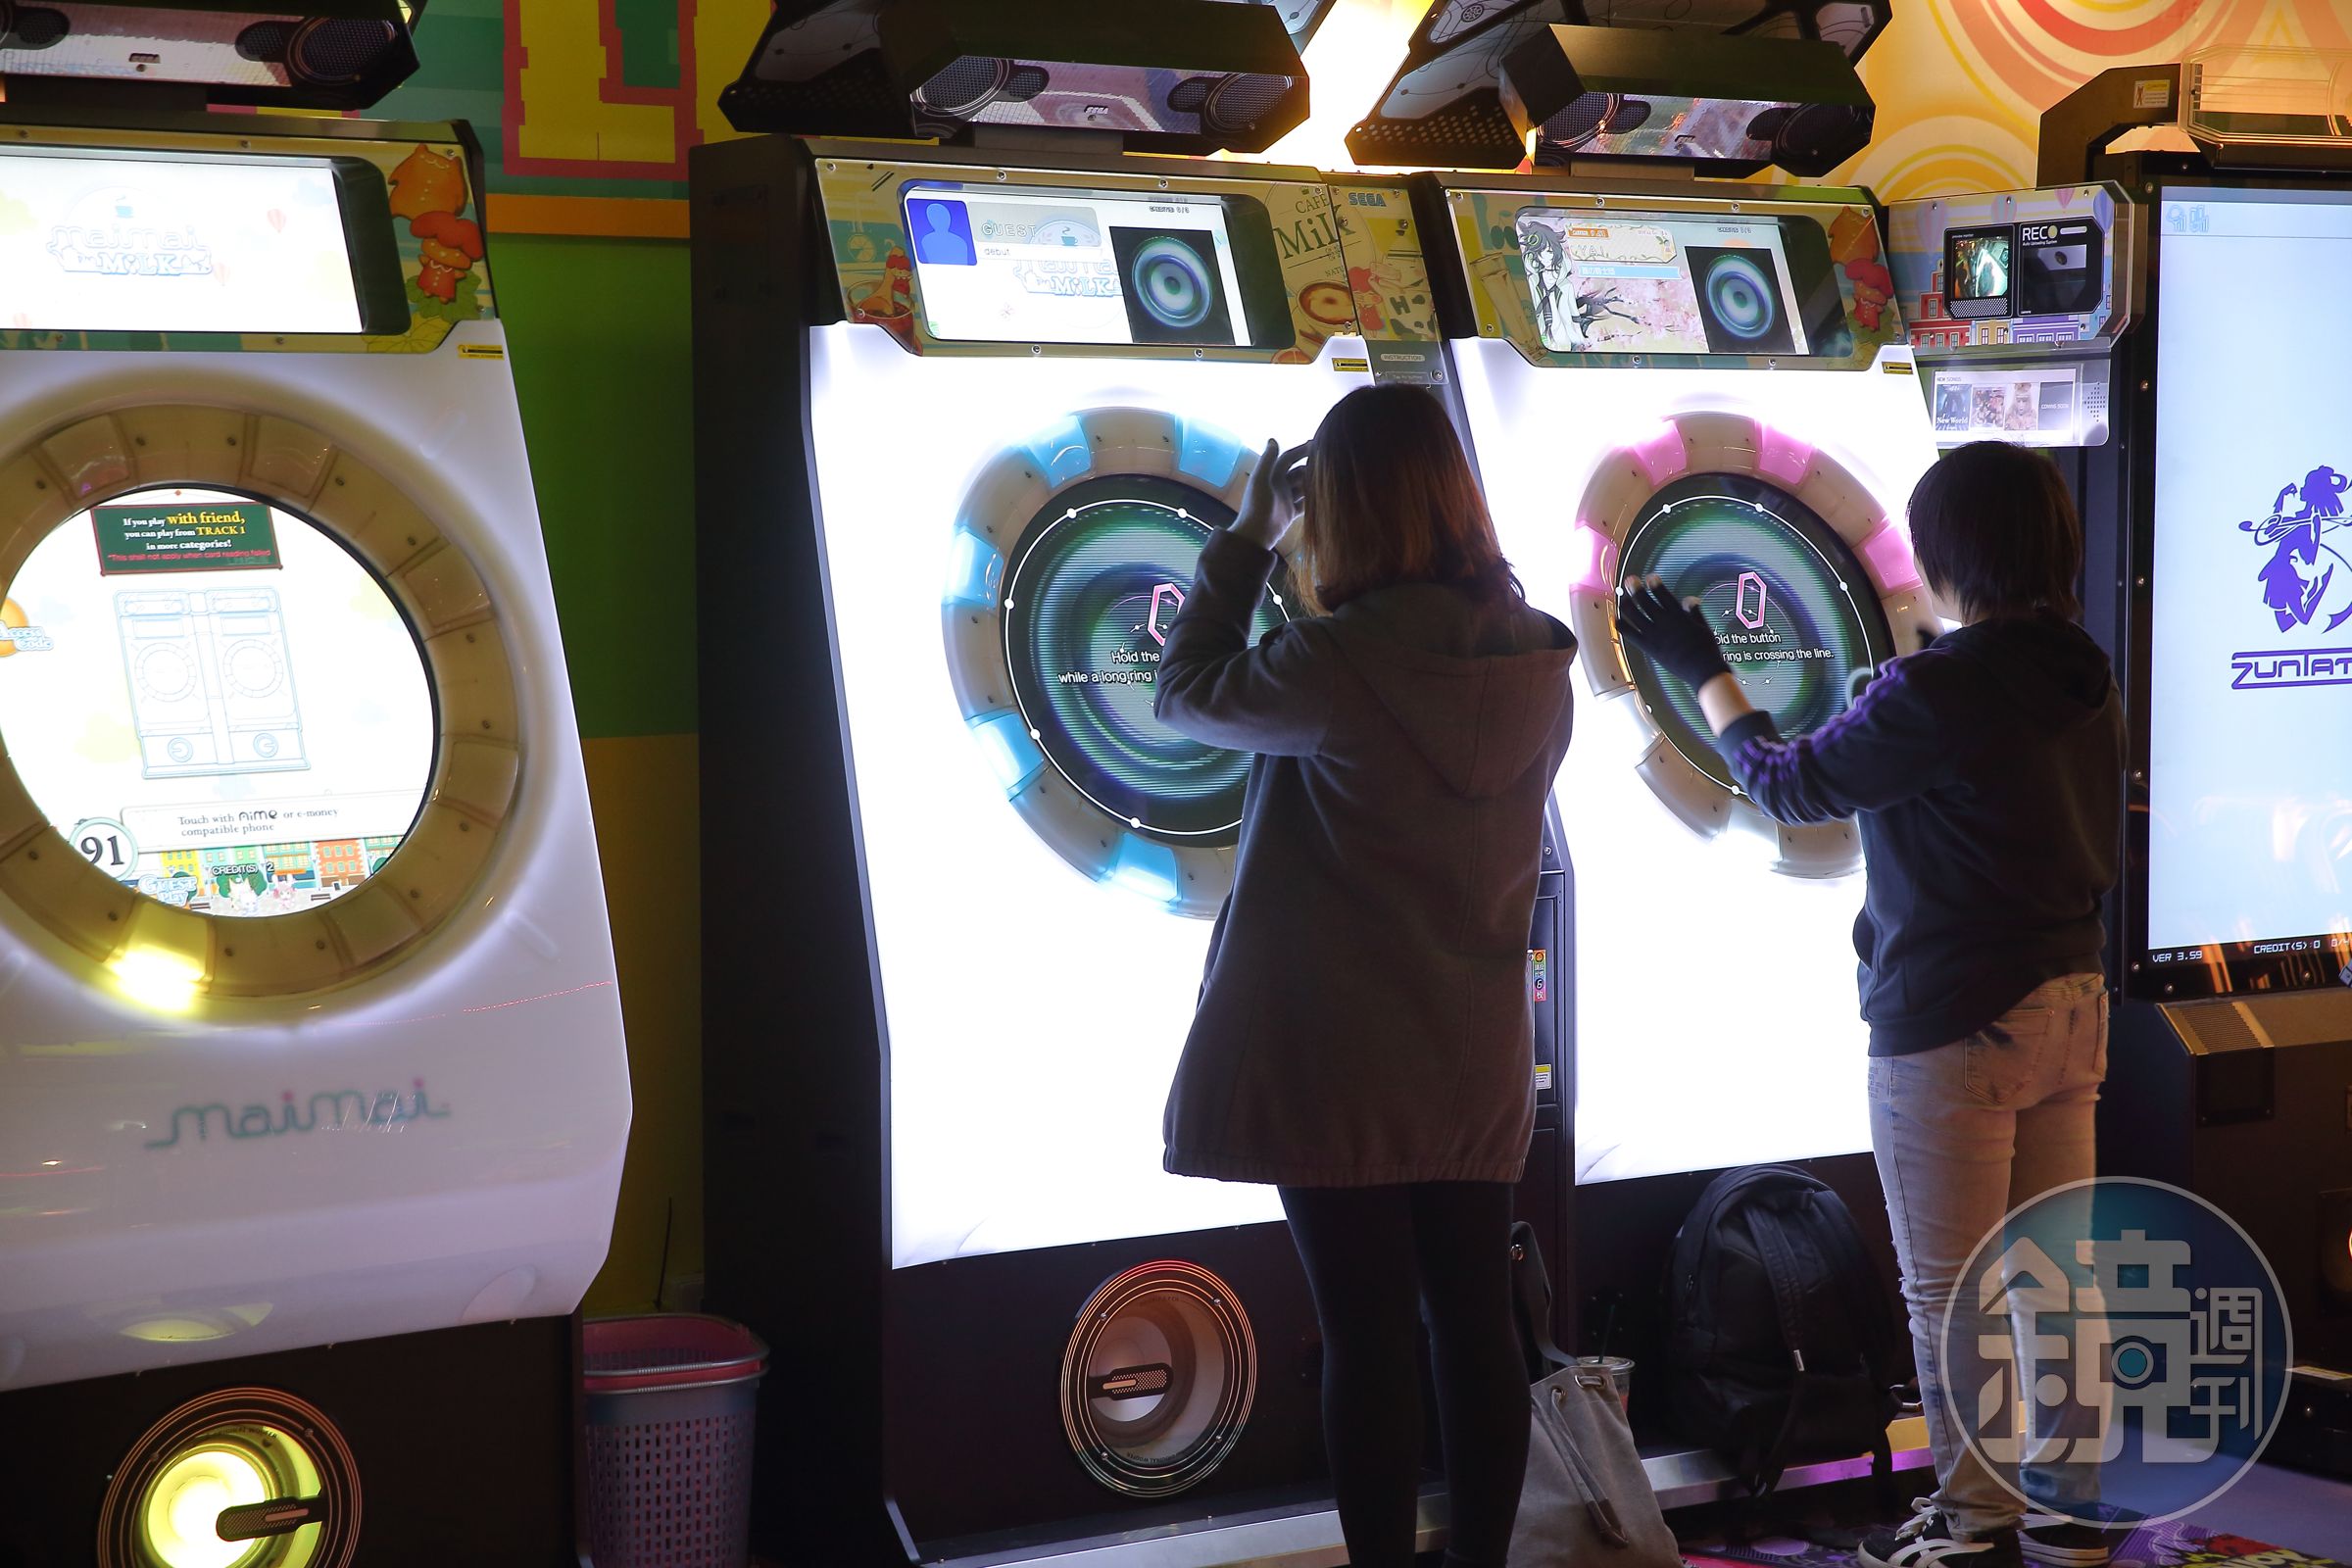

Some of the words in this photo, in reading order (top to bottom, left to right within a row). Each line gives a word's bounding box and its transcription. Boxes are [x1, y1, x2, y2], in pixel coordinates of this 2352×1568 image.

[1296, 194, 1330, 213] CAFE
[1348, 192, 1387, 207] SEGA
[981, 223, 1037, 238] GUEST
[1936, 416, 1950, 424] New
[1950, 416, 1968, 424] World
[148, 517, 166, 527] play
[167, 513, 197, 525] with
[200, 511, 245, 524] friend,
[124, 531, 141, 540] you
[157, 529, 174, 539] play
[174, 528, 196, 537] from
[196, 526, 237, 536] TRACK
[179, 540, 231, 552] categories!
[1715, 634, 1730, 645] old
[1732, 634, 1748, 644] the
[1749, 634, 1781, 644] button
[1111, 652, 1138, 663] Hold
[1141, 652, 1160, 662] the
[1723, 651, 1741, 662] ring
[1743, 651, 1752, 661] is
[1754, 650, 1794, 662] crossing
[1796, 649, 1813, 659] the
[1814, 648, 1834, 659] line.
[1058, 671, 1088, 684] while
[1092, 673, 1098, 682] a
[1102, 671, 1127, 684] long
[1129, 670, 1152, 683] ring
[178, 815, 209, 825] Touch
[212, 813, 234, 823] with
[297, 808, 338, 820] e-money
[181, 825, 239, 837] compatible
[242, 823, 274, 834] phone
[80, 835, 124, 866] 91
[212, 862, 259, 876] CREDIT(S)
[266, 861, 275, 872] 2
[2152, 953, 2172, 962] VER
[2177, 950, 2202, 961] 3.59
[143, 1077, 451, 1150] maimai
